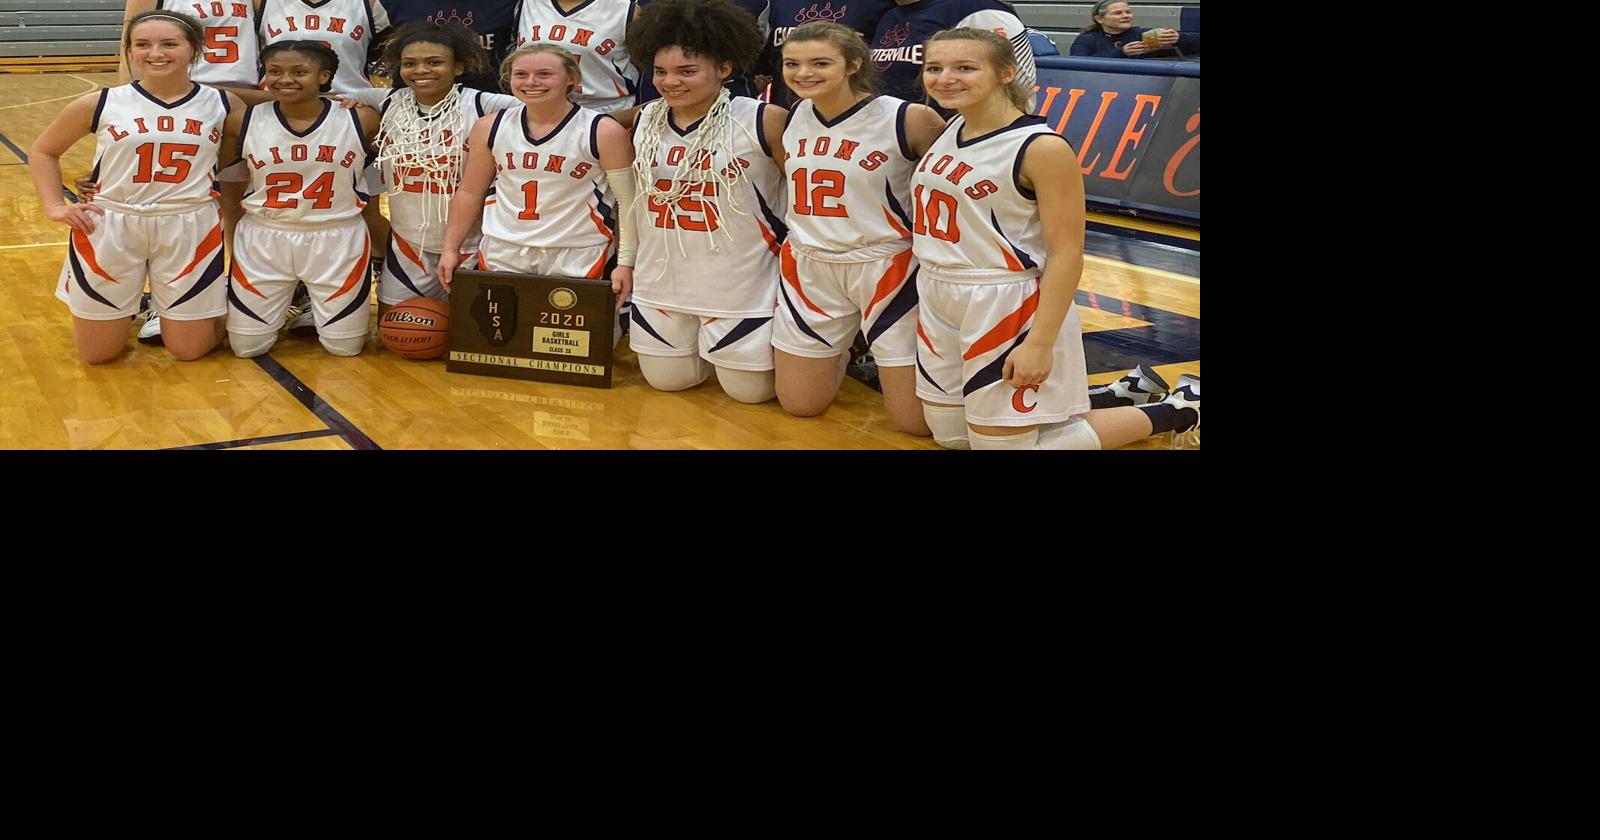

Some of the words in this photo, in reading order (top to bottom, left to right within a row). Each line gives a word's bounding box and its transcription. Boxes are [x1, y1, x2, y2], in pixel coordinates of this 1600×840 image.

[267, 15, 364, 41] LIONS
[107, 115, 221, 144] LIONS
[1033, 86, 1162, 181] LLE
[132, 142, 200, 184] 15
[248, 144, 357, 170] LIONS
[638, 145, 750, 179] ONS
[785, 136, 889, 171] IONS
[262, 171, 335, 209] 24
[518, 180, 540, 220] 1
[648, 179, 720, 232] 45
[792, 168, 849, 217] 12
[913, 184, 960, 244] 10
[384, 311, 436, 327] Wilson
[540, 312, 585, 327] 2020
[552, 331, 570, 339] GIRLS
[542, 337, 579, 347] BASKETBALL
[456, 352, 519, 366] SECTIONAL
[529, 359, 597, 374] CHAMPIONS
[1012, 384, 1040, 414] C
